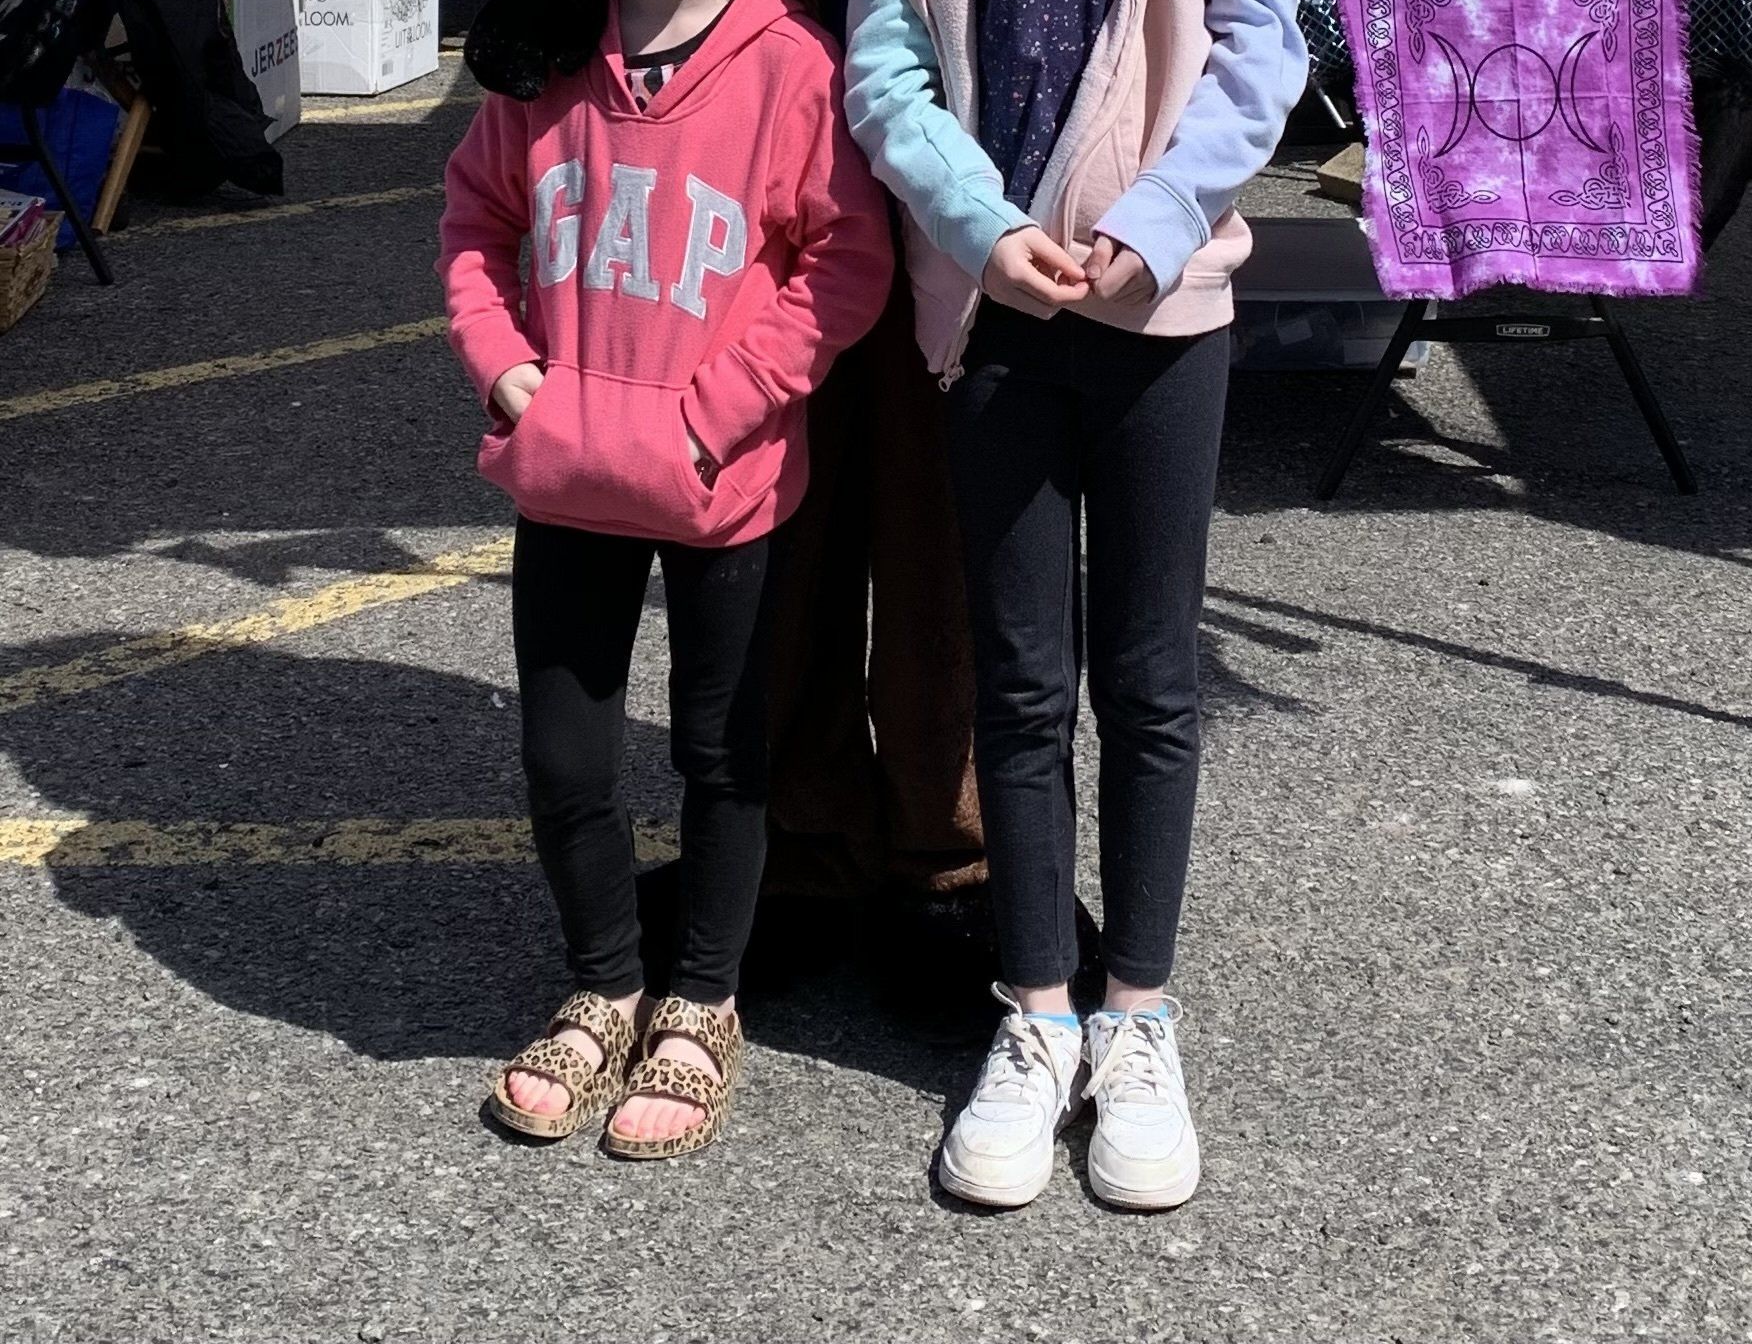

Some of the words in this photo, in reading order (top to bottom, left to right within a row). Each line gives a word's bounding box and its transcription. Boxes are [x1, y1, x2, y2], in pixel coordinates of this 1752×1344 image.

[304, 10, 350, 26] LOOM
[533, 157, 748, 320] GAP
[1502, 326, 1544, 335] LIFETIME
